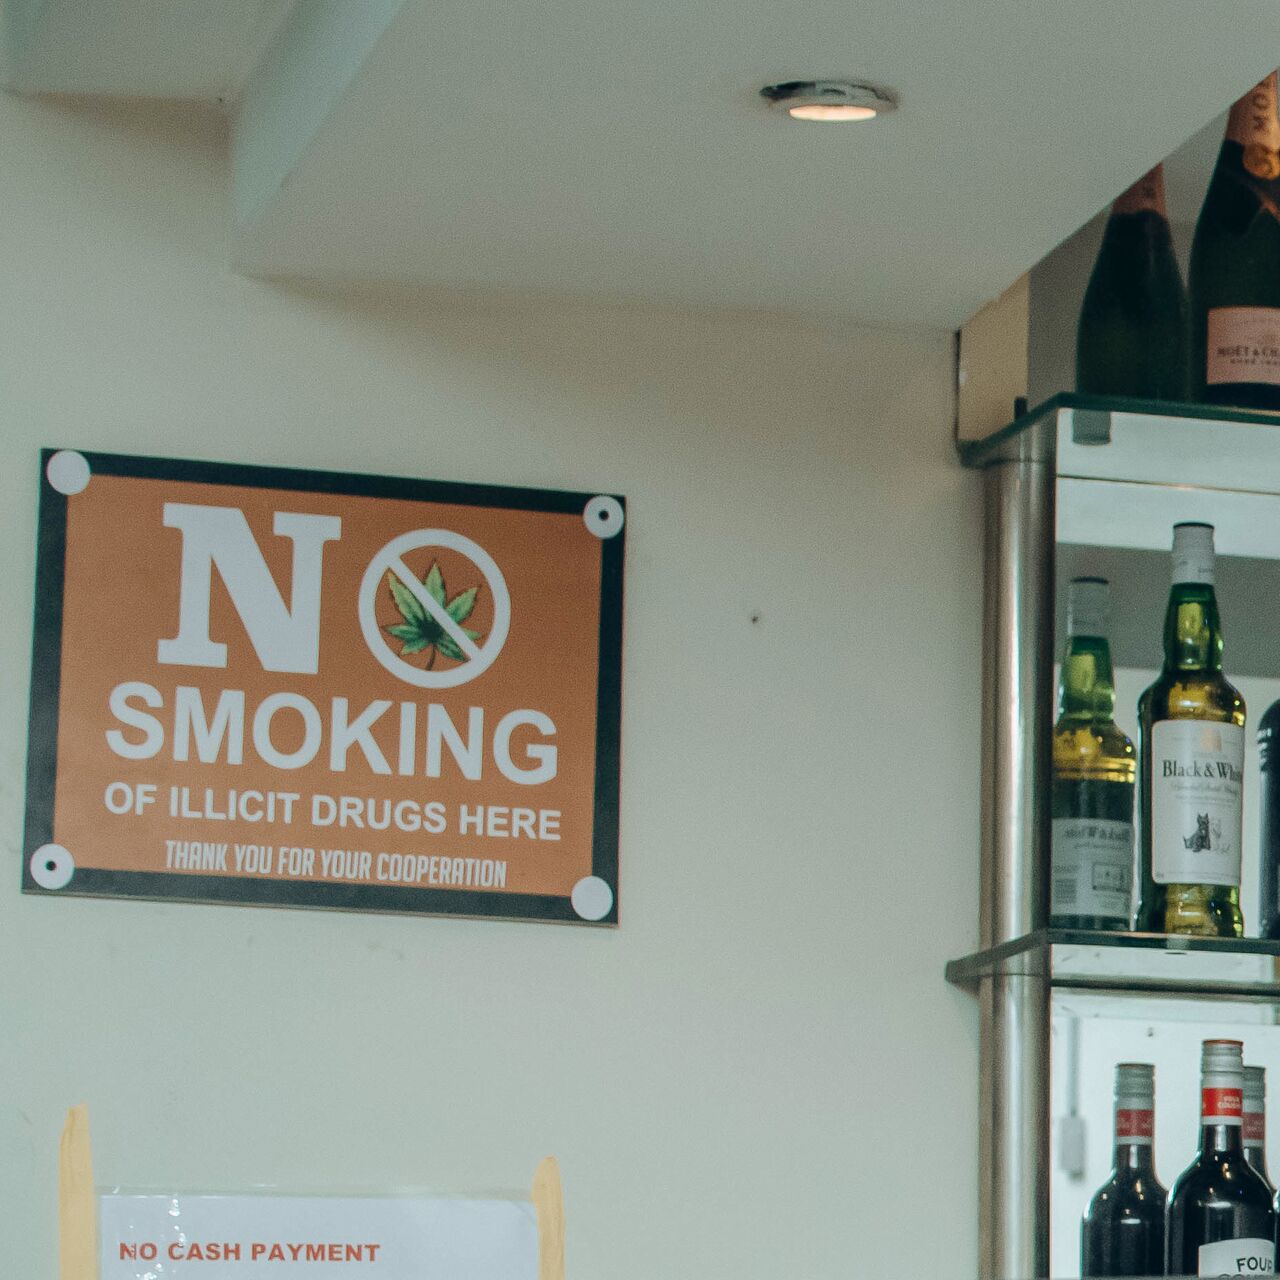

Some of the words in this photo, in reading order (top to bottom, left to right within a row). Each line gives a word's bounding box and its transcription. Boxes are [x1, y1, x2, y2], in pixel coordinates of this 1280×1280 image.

[104, 681, 559, 785] SMOKING
[1163, 758, 1201, 778] Black
[1203, 761, 1215, 778] &
[104, 782, 156, 817] OF
[170, 786, 299, 826] ILLICIT
[311, 794, 447, 834] DRUGS
[459, 804, 562, 841] HERE
[165, 839, 227, 873] THANK
[235, 842, 272, 875] YOU
[279, 846, 314, 878] FOR
[322, 849, 371, 882] YOUR
[377, 853, 507, 889] COOPERATION
[119, 1243, 158, 1262] NO
[168, 1243, 241, 1263] CASH
[251, 1243, 380, 1264] PAYMENT
